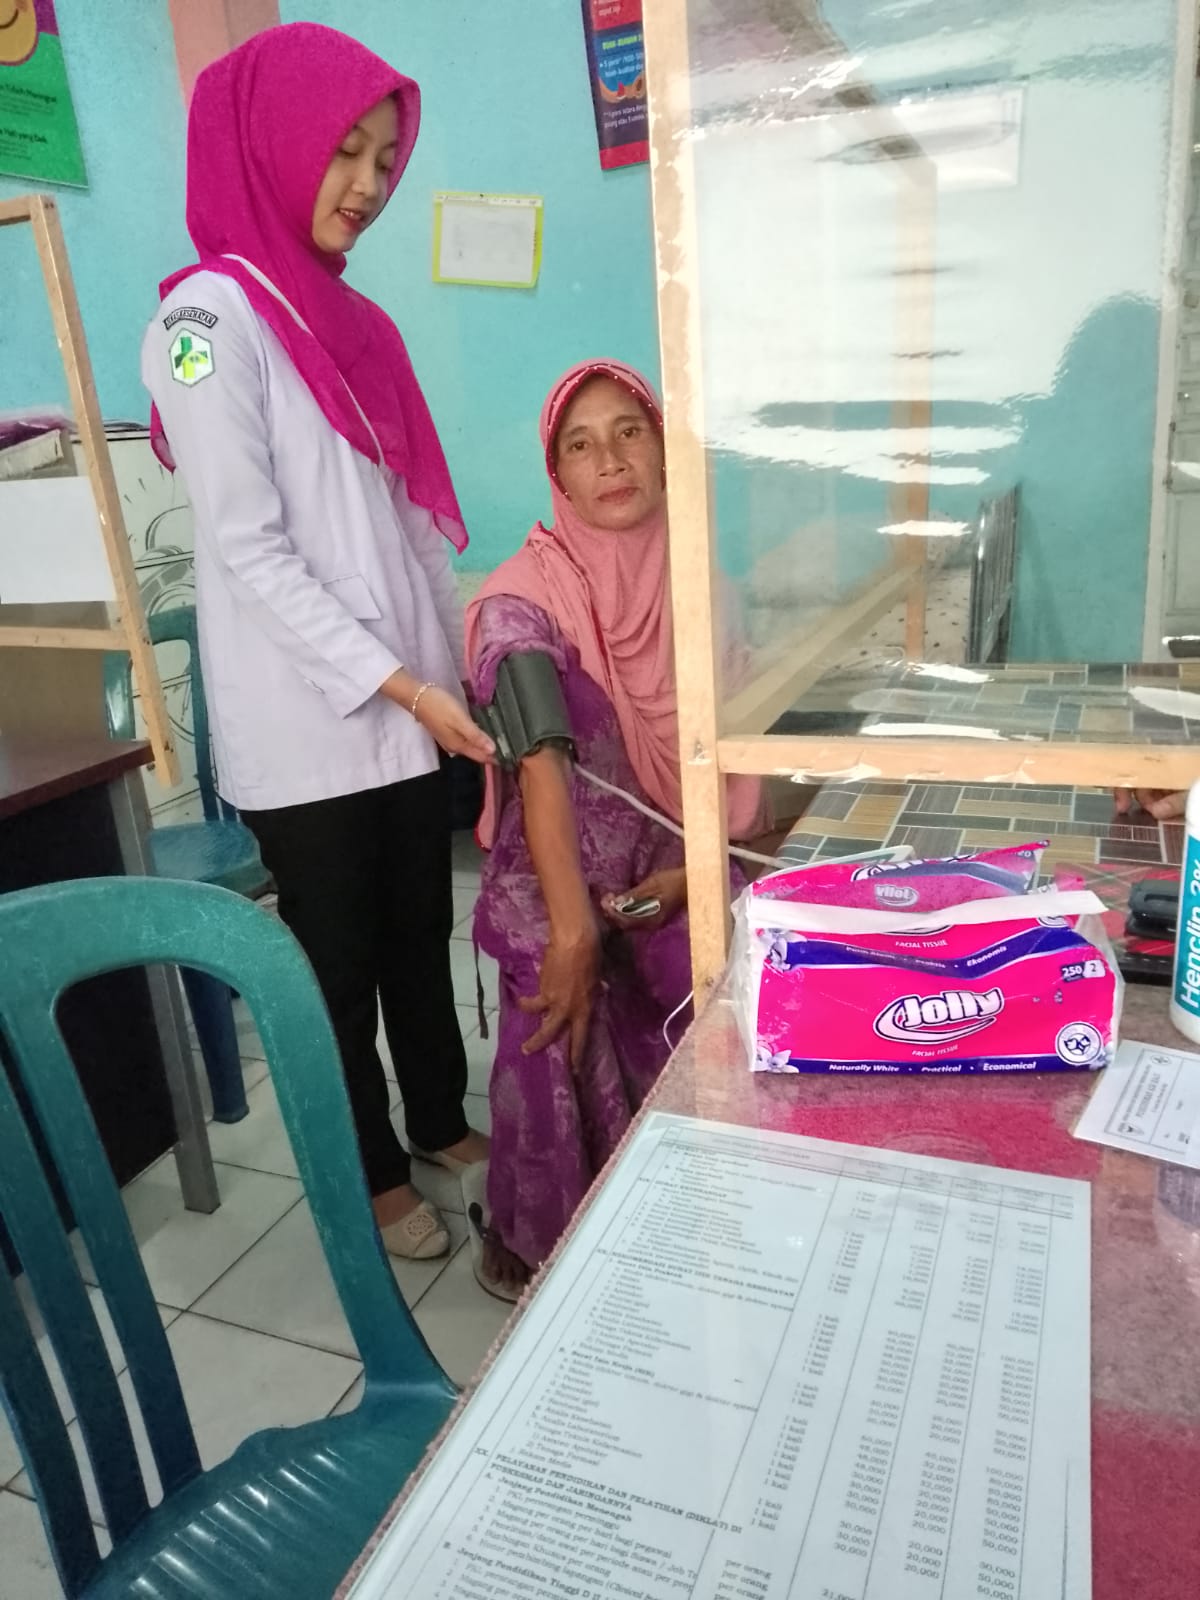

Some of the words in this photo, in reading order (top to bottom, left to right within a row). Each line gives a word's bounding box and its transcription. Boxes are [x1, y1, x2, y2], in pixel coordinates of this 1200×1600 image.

[895, 940, 921, 948] FACIAL
[922, 939, 948, 948] TISSUE
[966, 945, 1007, 968] Ekonomis
[1062, 966, 1083, 977] 250
[902, 987, 1003, 1028] Jolly
[829, 1063, 872, 1073] Naturally
[873, 1064, 899, 1073] White
[921, 1064, 962, 1073] Practical
[983, 1061, 1037, 1072] Economical
[489, 1462, 544, 1484] PUSKESMAS
[544, 1479, 565, 1490] DAN
[564, 1485, 633, 1511] JARINGANNYA
[494, 1453, 548, 1474] PELAYANAN
[547, 1469, 606, 1492] PENDIDIKAN
[606, 1486, 627, 1499] DAN
[628, 1493, 684, 1516] PELATIHAN
[684, 1510, 728, 1530] (DIKLAT)
[729, 1523, 742, 1534] DI
[496, 1476, 534, 1493] Jenjang
[532, 1486, 585, 1507] Pendidikan
[584, 1502, 633, 1523] Menengah
[533, 1510, 550, 1521] per
[549, 1515, 577, 1530] orang
[576, 1524, 592, 1535] per
[593, 1527, 614, 1540] hari
[633, 1540, 673, 1560] pegawai
[528, 1520, 545, 1531] per
[544, 1525, 572, 1540] orang
[571, 1534, 588, 1545] per
[588, 1538, 609, 1551] hari
[666, 1563, 686, 1575] Job
[566, 1557, 583, 1568] per
[582, 1562, 612, 1578] orang
[578, 1548, 595, 1560] per
[595, 1552, 630, 1571] periode
[654, 1573, 671, 1585] per
[724, 1559, 742, 1571] per
[742, 1564, 772, 1580] orang
[905, 1551, 942, 1568] 20,000
[454, 1546, 496, 1567] Jenjang
[493, 1558, 549, 1583] Pendidikan
[547, 1577, 582, 1597] Tinggi
[720, 1570, 738, 1582] per
[738, 1575, 769, 1592] orang
[977, 1572, 1015, 1590] 50,000
